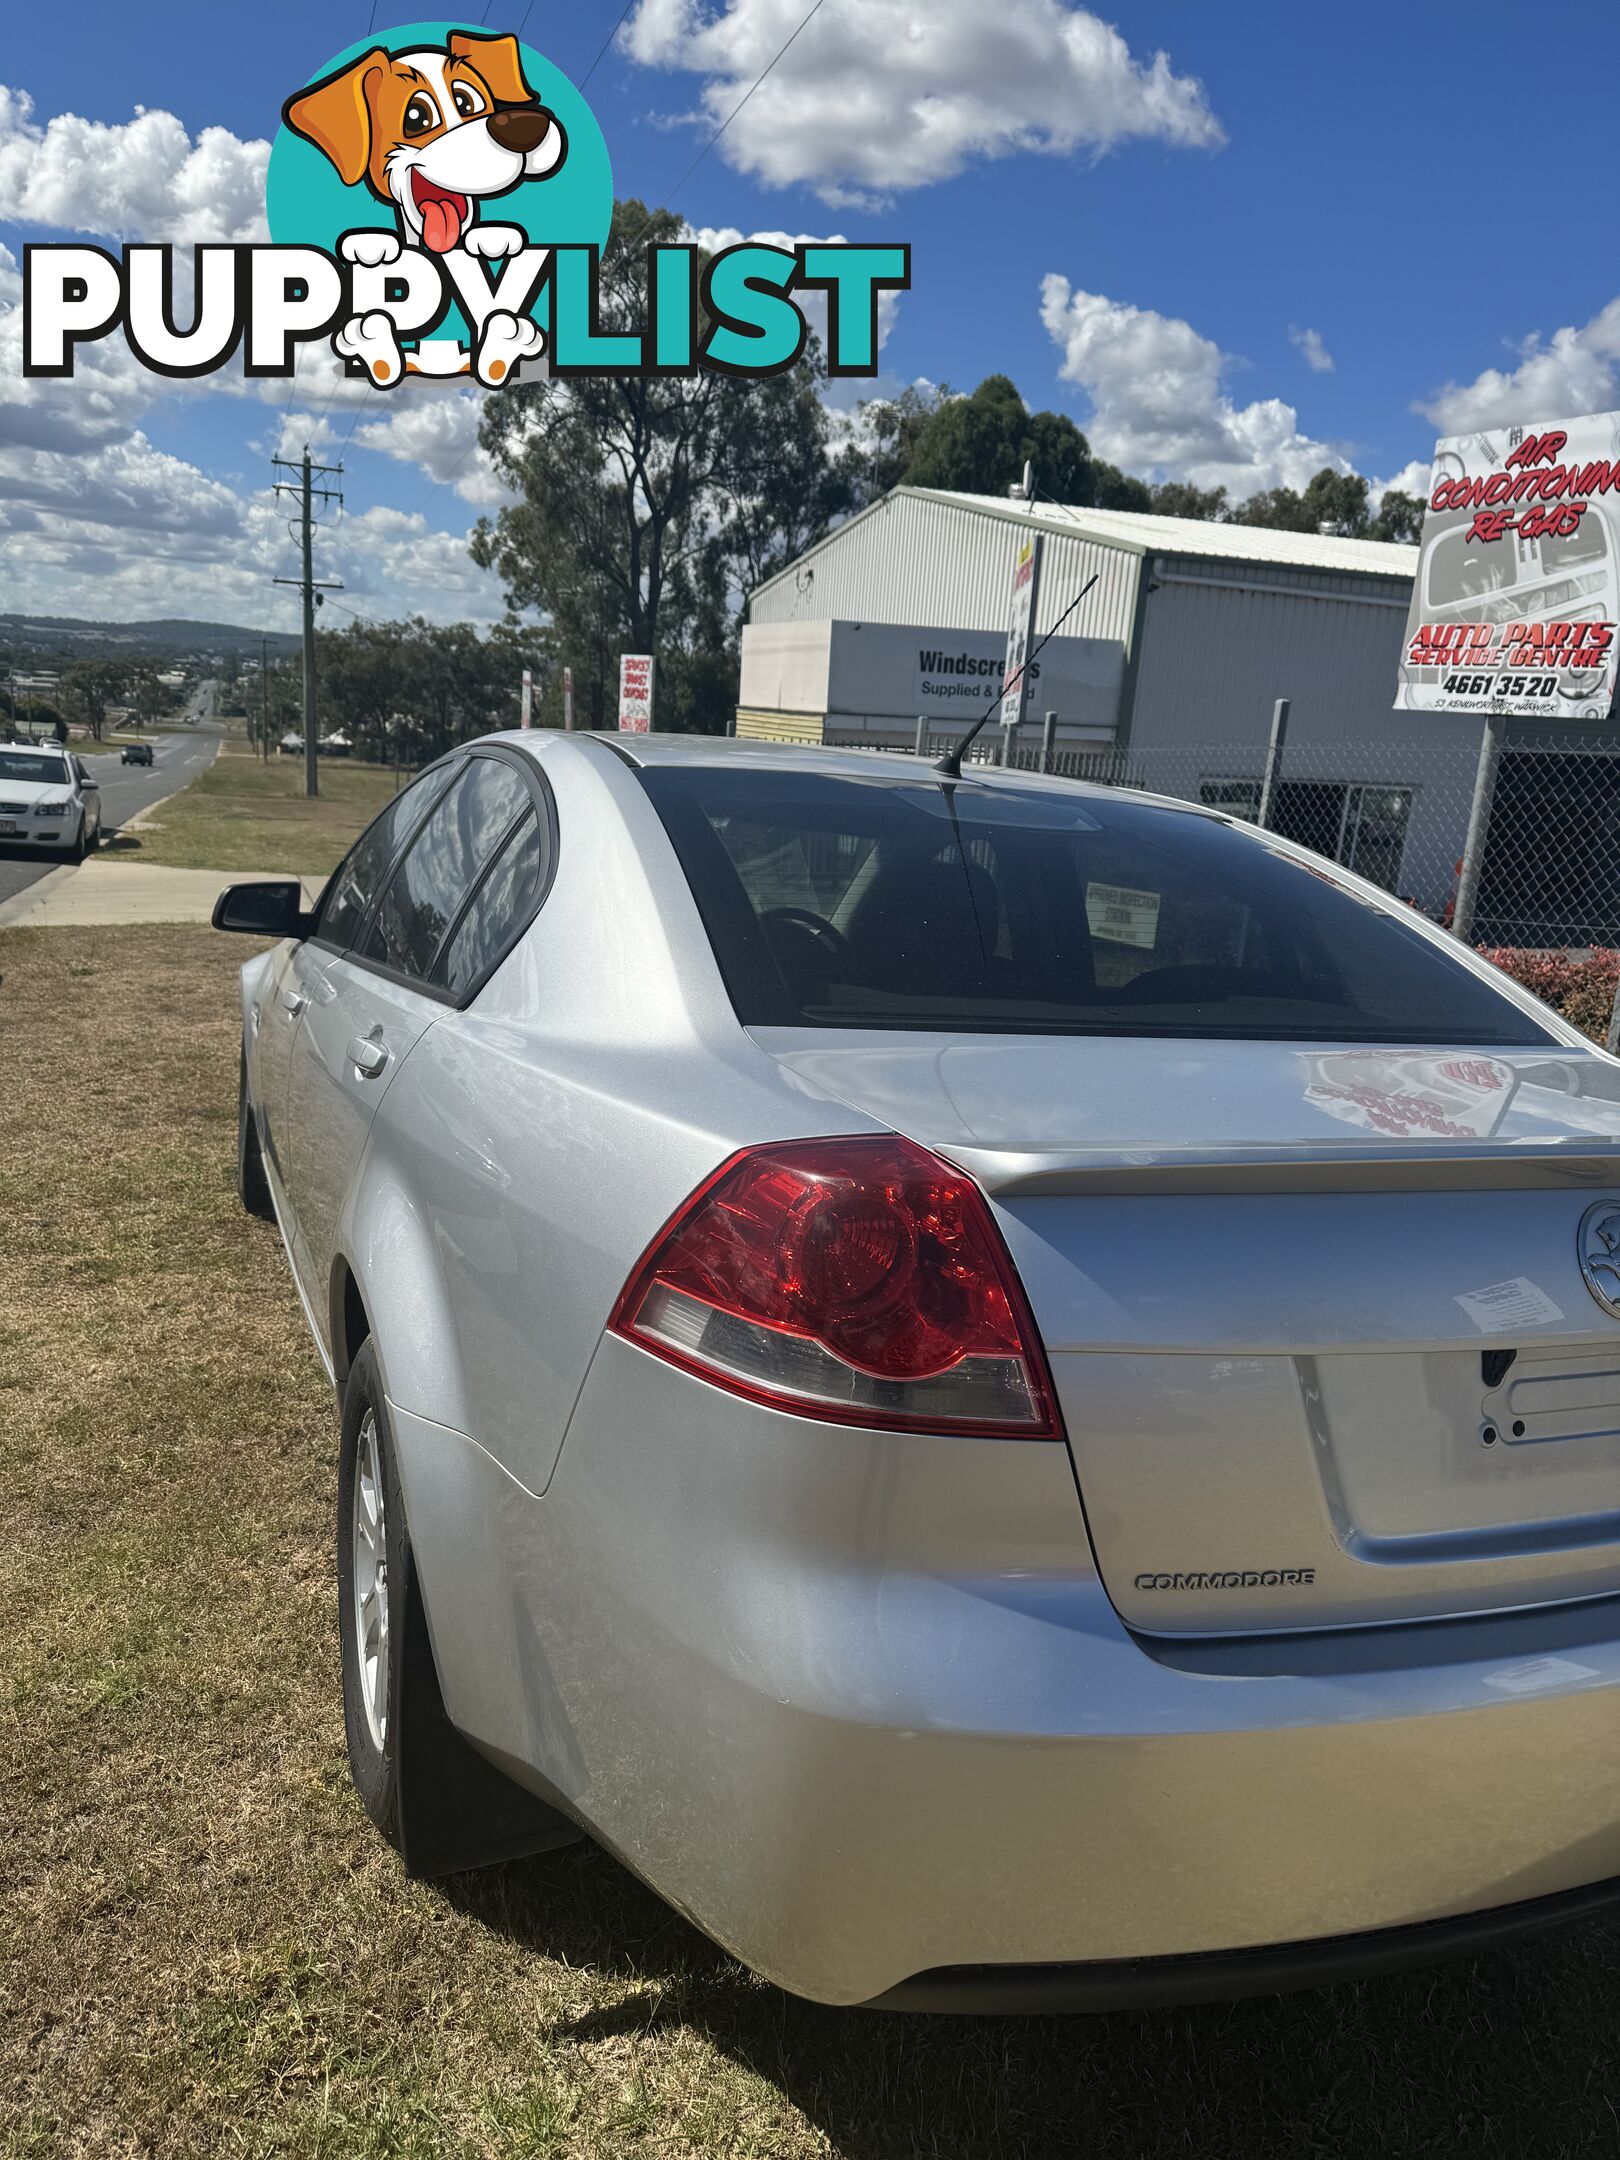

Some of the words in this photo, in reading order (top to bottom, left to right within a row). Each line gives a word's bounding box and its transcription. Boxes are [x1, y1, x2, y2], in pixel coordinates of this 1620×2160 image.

[1505, 431, 1567, 471] AIR
[1431, 459, 1620, 511] CONDITIONIN
[1465, 502, 1587, 544] RE-GAS
[1409, 623, 1494, 648] AUTO
[1501, 622, 1619, 648] PARTS
[919, 650, 1040, 679] Windscres
[1408, 648, 1504, 666] SERVICE
[1508, 648, 1611, 667] CENTRE
[921, 681, 979, 698] Supplied
[984, 685, 993, 697] &
[1443, 675, 1492, 695] 4661
[1496, 677, 1557, 698] 3520
[1135, 1569, 1315, 1590] COMMODORE
